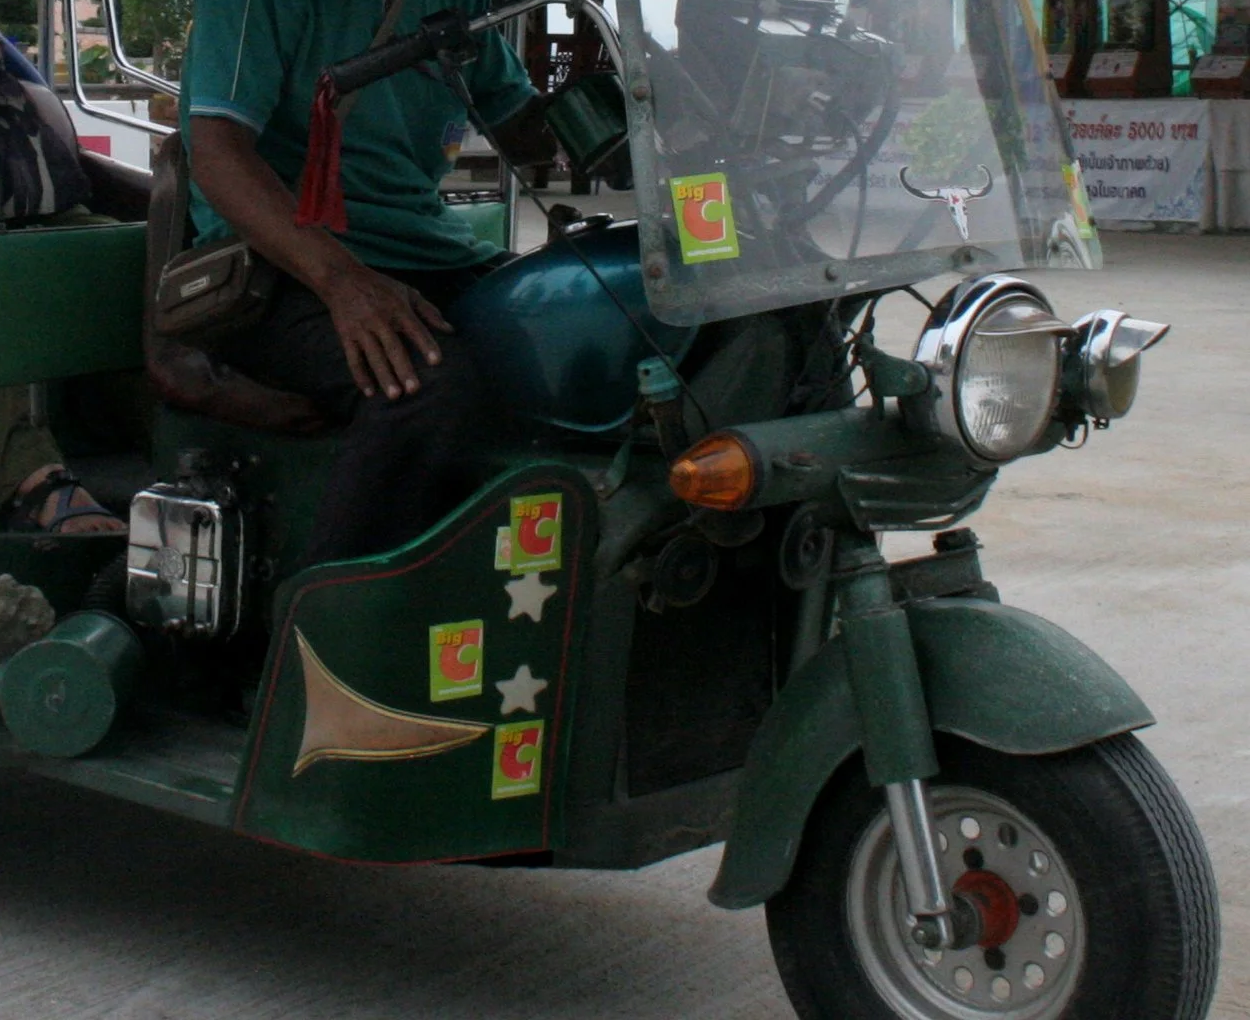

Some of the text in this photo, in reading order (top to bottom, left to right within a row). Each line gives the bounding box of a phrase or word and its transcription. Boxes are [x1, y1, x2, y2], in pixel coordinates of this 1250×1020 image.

[1127, 121, 1165, 141] 5000
[1170, 122, 1198, 140] บาท
[676, 185, 705, 202] Big
[682, 181, 726, 243] C
[517, 503, 542, 520] Big
[518, 501, 561, 557] C
[436, 631, 464, 647] Big
[439, 628, 483, 683] C
[498, 730, 524, 746] Big
[500, 727, 542, 782] C
